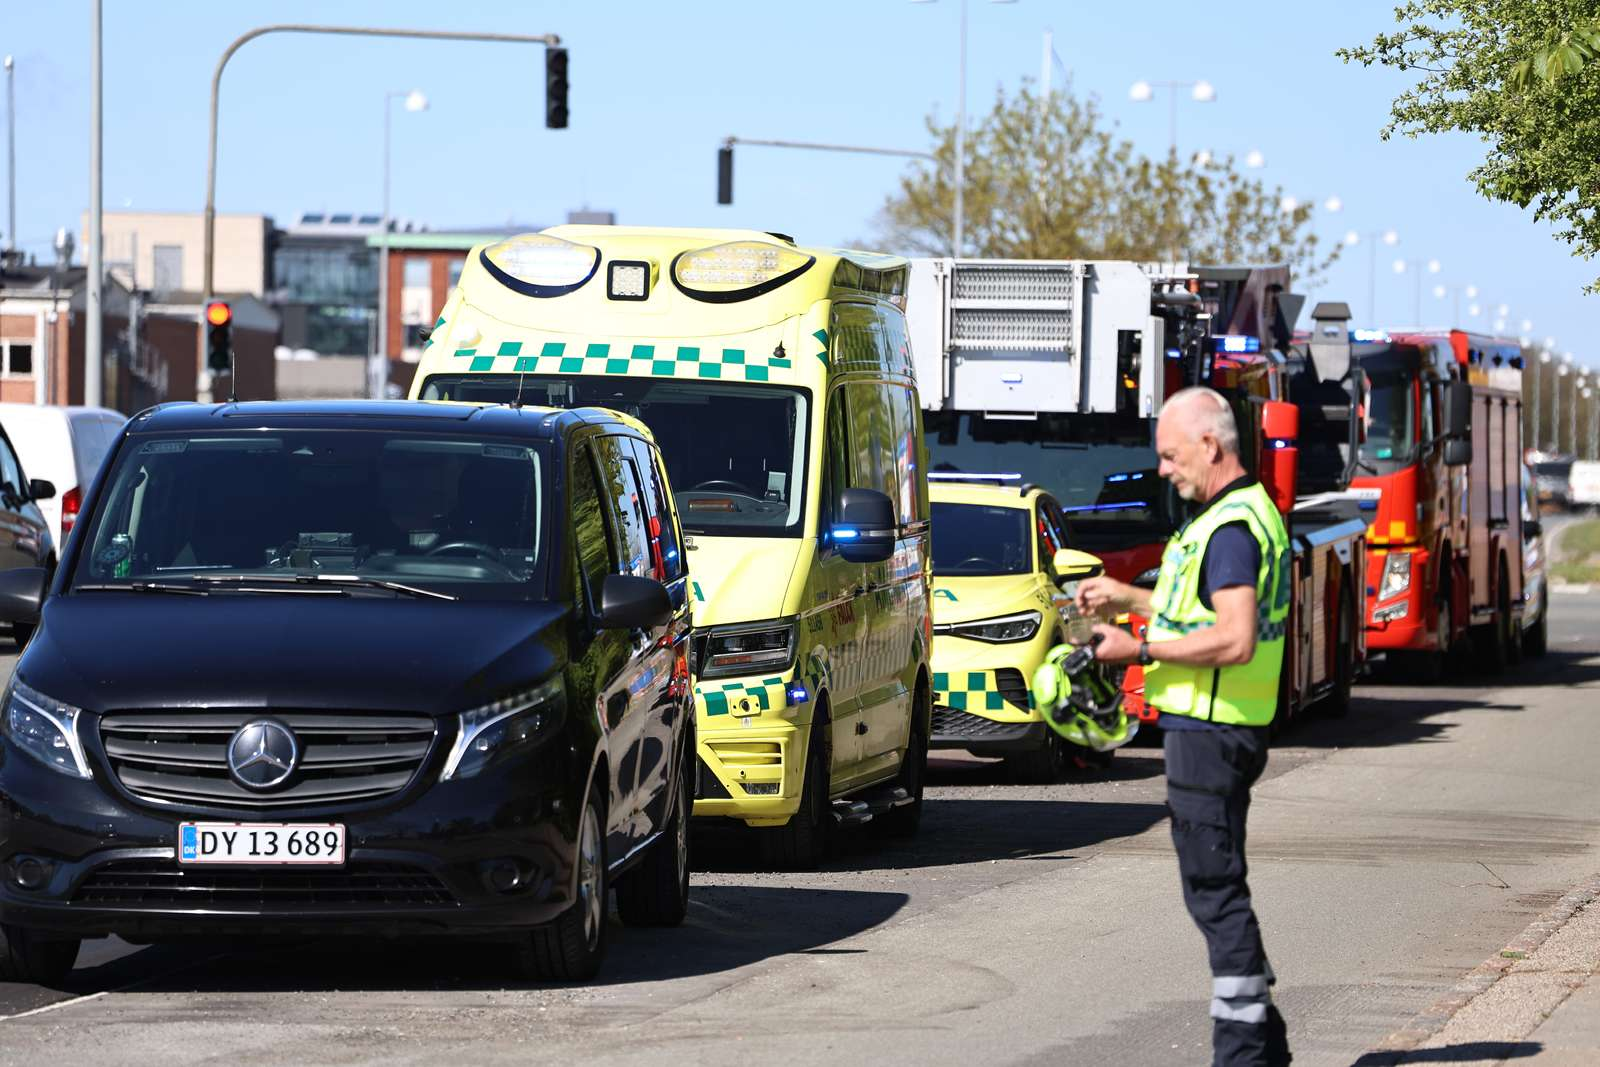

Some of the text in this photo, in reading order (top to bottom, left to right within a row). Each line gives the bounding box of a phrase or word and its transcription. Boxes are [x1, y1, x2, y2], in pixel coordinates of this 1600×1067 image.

[183, 846, 196, 855] DK
[200, 830, 339, 857] DY 13 689
